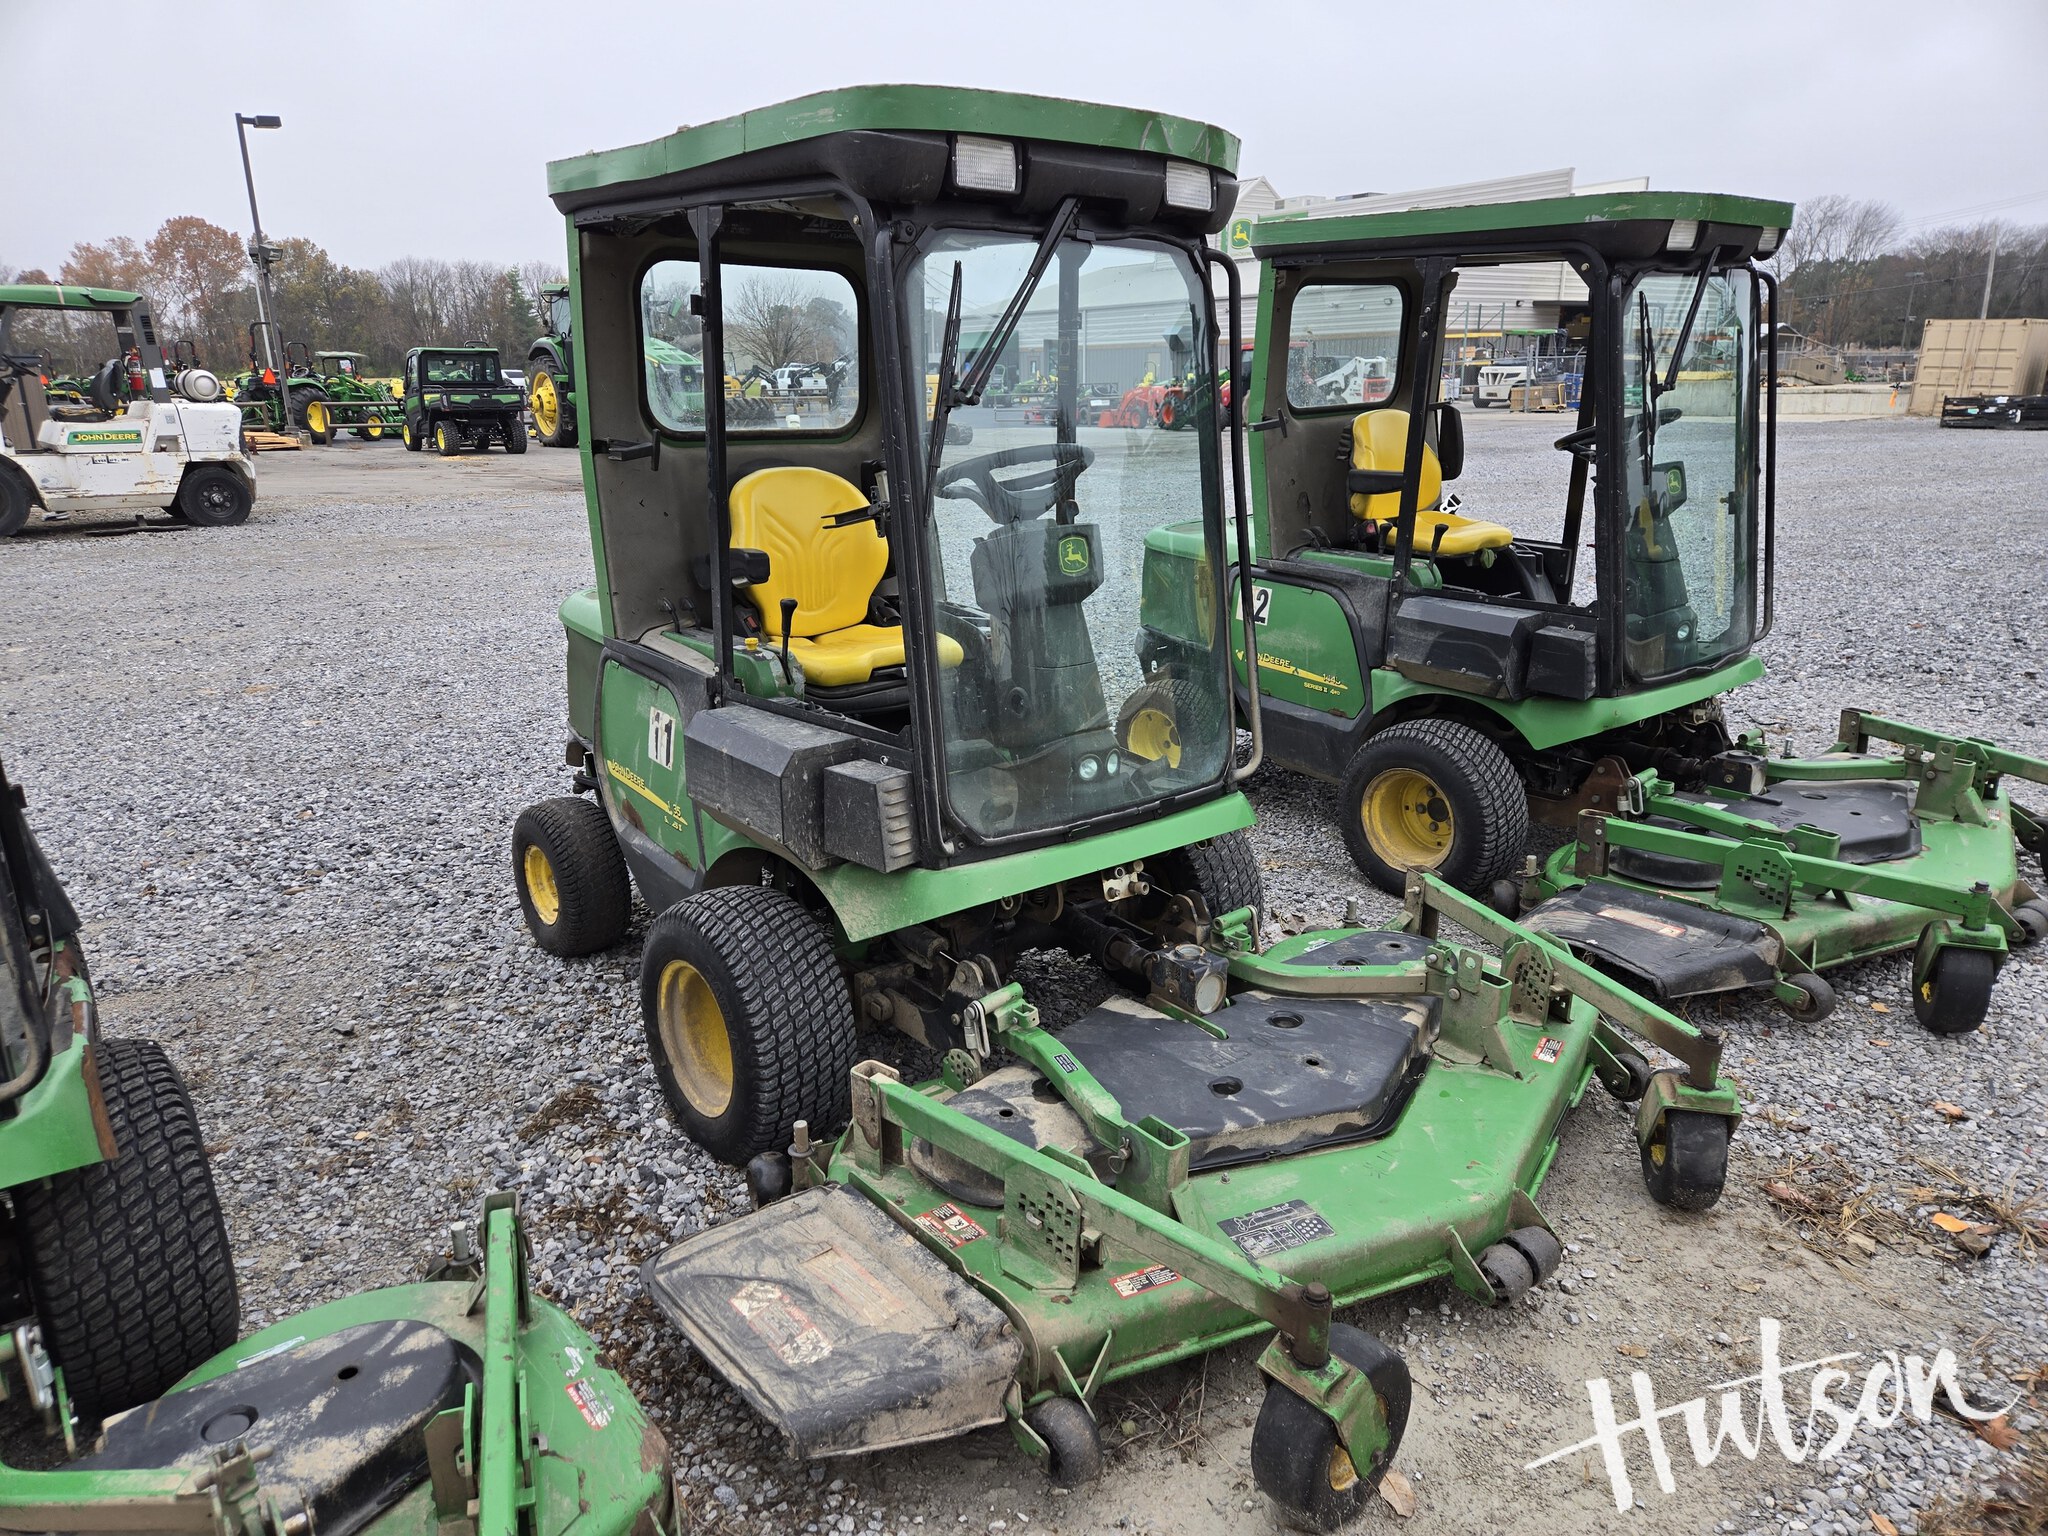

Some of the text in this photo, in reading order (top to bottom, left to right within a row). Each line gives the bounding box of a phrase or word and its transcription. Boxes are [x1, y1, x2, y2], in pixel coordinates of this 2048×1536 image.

[75, 432, 138, 442] JOHN DEERE
[1253, 588, 1269, 624] 2
[1264, 653, 1291, 668] DEERE
[651, 710, 673, 767] 11
[611, 758, 646, 790] JOHN DEERE
